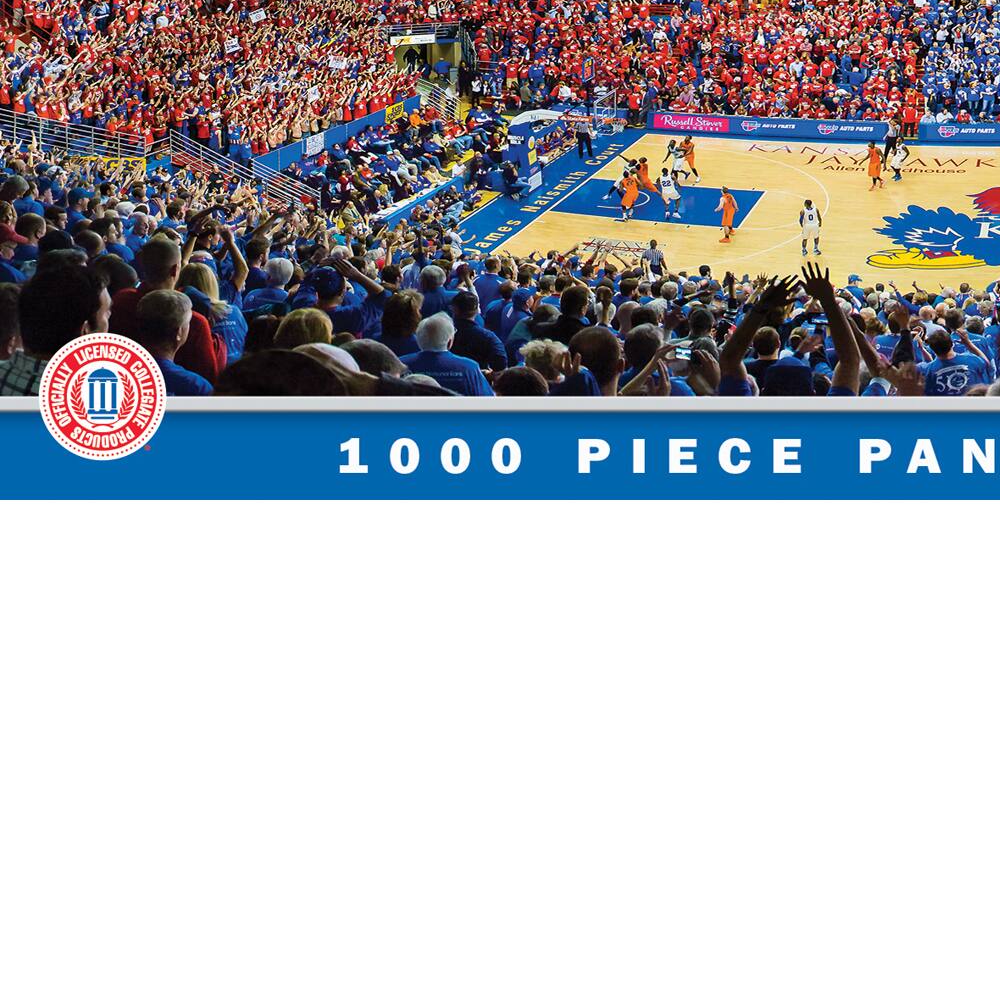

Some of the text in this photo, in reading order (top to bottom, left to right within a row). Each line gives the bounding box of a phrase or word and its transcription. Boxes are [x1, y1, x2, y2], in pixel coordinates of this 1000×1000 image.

[661, 115, 723, 128] Russell Stover
[520, 171, 588, 213] Naismith
[585, 143, 624, 167] Court
[51, 344, 155, 448] OFFICIALLY LICENSED COLLEGIATE PRODUCTS
[338, 437, 523, 475] 1000
[578, 437, 802, 475] PIECE
